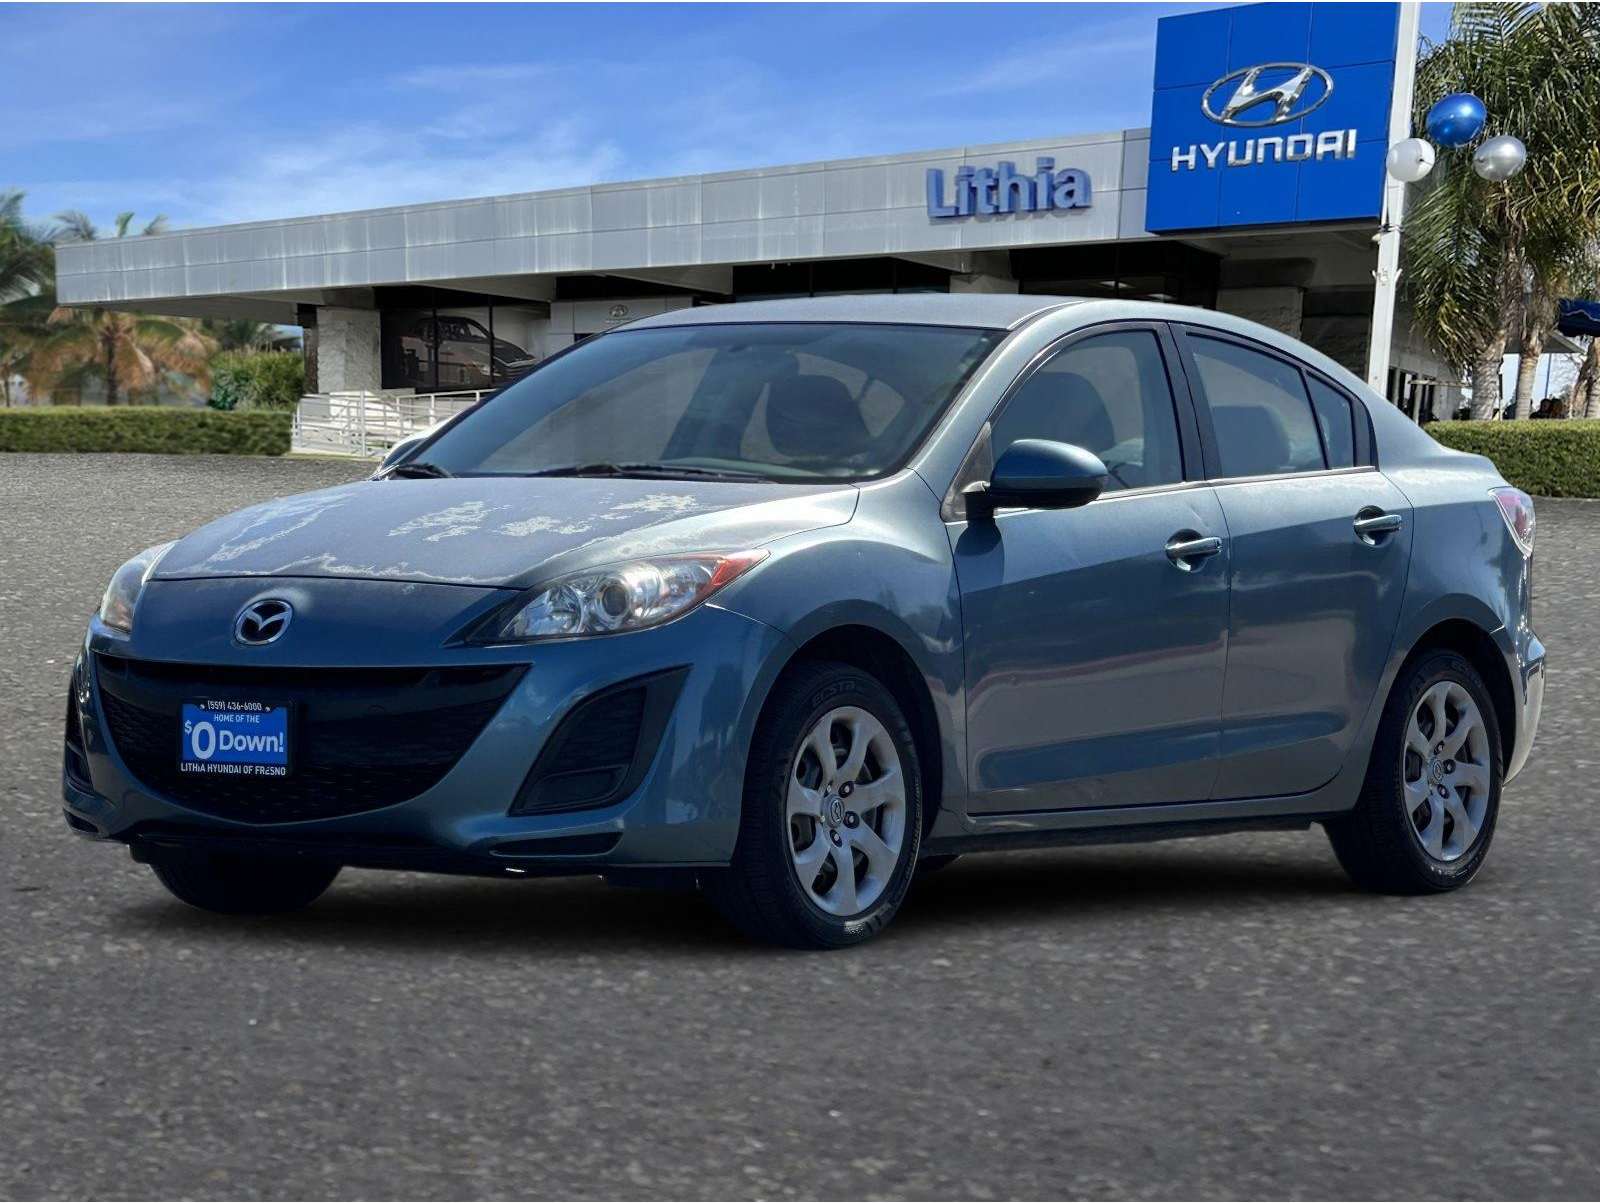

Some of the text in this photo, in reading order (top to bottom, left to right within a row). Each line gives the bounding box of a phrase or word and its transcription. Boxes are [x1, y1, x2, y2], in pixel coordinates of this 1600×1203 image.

[1171, 128, 1357, 172] HYUNDAI
[926, 157, 1093, 217] Lithia
[207, 700, 262, 711] (559) 436-6000
[214, 713, 260, 723] HOME OF THE
[219, 730, 284, 753] Down!
[180, 762, 286, 776] LITHIA HYUNDAI OF FRESNO
